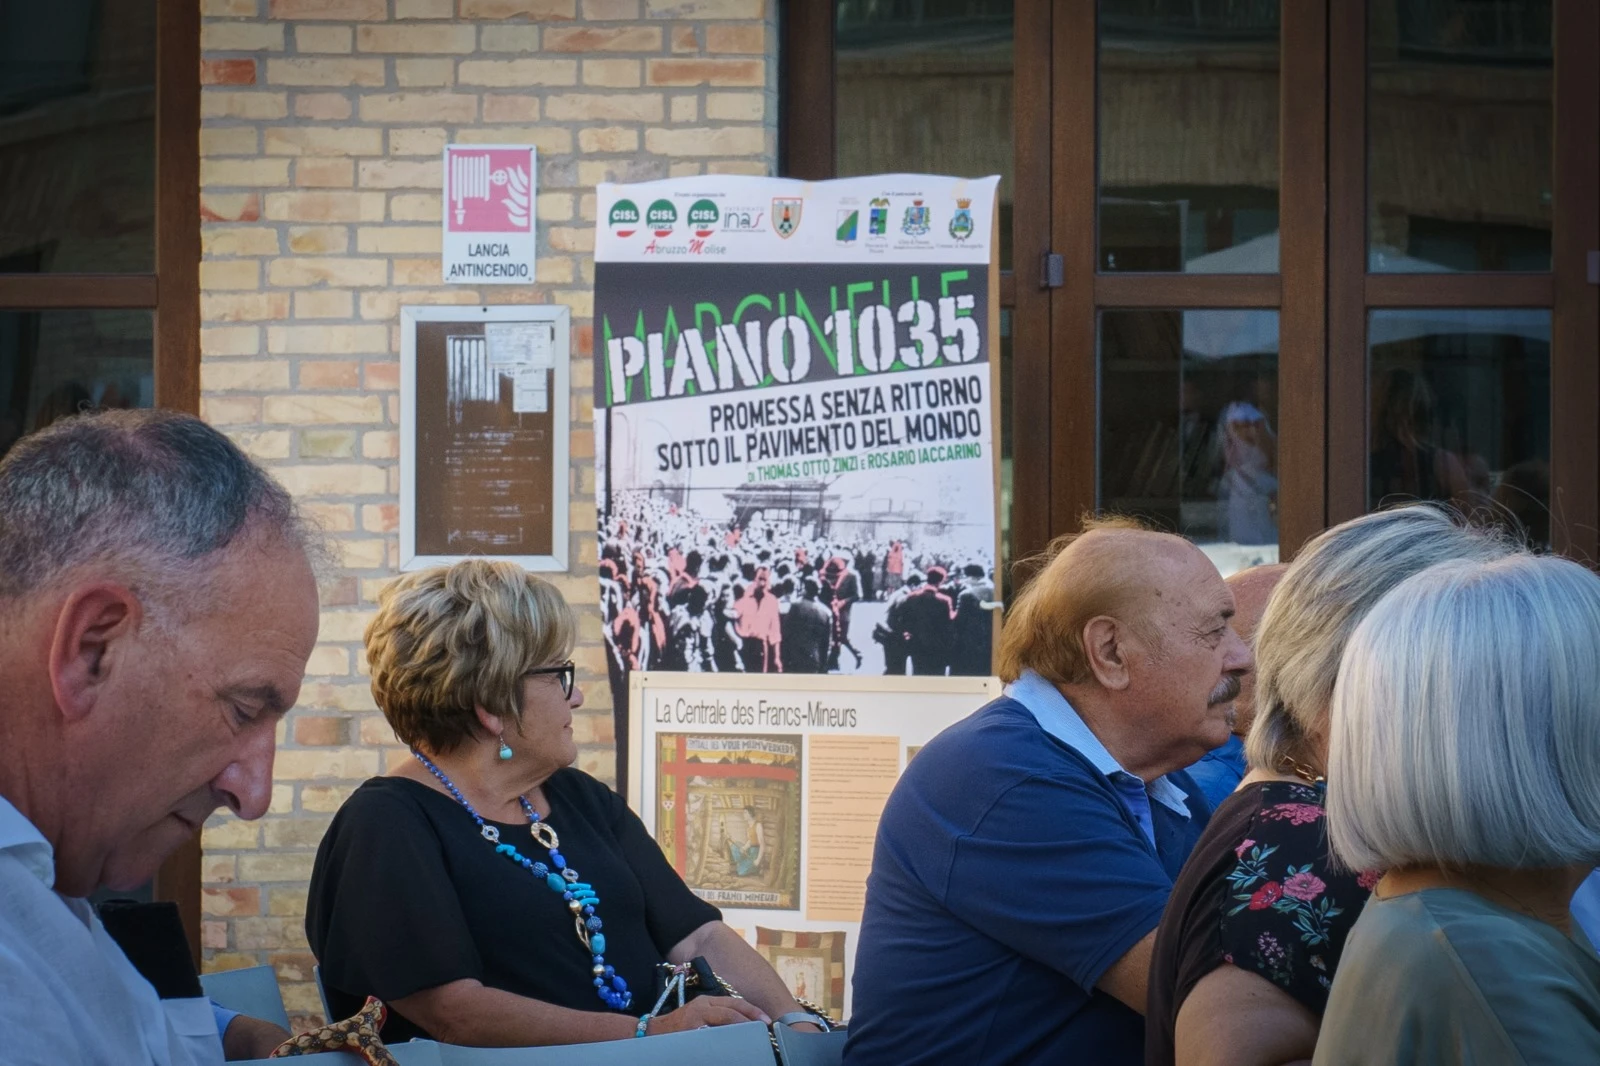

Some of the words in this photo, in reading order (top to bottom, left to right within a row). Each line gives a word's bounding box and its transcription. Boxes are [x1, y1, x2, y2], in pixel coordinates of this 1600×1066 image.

[612, 210, 637, 220] CISL
[649, 210, 675, 220] CISL
[691, 210, 716, 220] CISL
[468, 243, 510, 257] LANCIA
[644, 239, 687, 254] Abruzzo
[688, 239, 726, 255] Molise
[450, 263, 528, 277] ANTINCENDIO
[607, 314, 811, 404] PIANO
[824, 294, 980, 376] 1035
[709, 394, 815, 433] PROMESSA
[821, 385, 886, 420] SENZA
[889, 375, 982, 412] RITORNO
[657, 437, 719, 472] SOTTO
[725, 434, 741, 463] IL
[746, 420, 856, 462] PAVIMENTO
[862, 416, 900, 447] DEL
[904, 408, 982, 444] MONDO
[748, 472, 755, 482] DI
[757, 461, 800, 481] THOMAS
[803, 457, 830, 476] OTTO
[833, 455, 858, 473] ZINZI
[861, 458, 866, 470] E
[868, 450, 916, 469] ROSARIO
[918, 442, 982, 464] IACCARINO
[655, 697, 671, 723] La
[675, 697, 727, 724] Centrale
[731, 699, 754, 726] des
[758, 699, 857, 728] Francs-Mineurs
